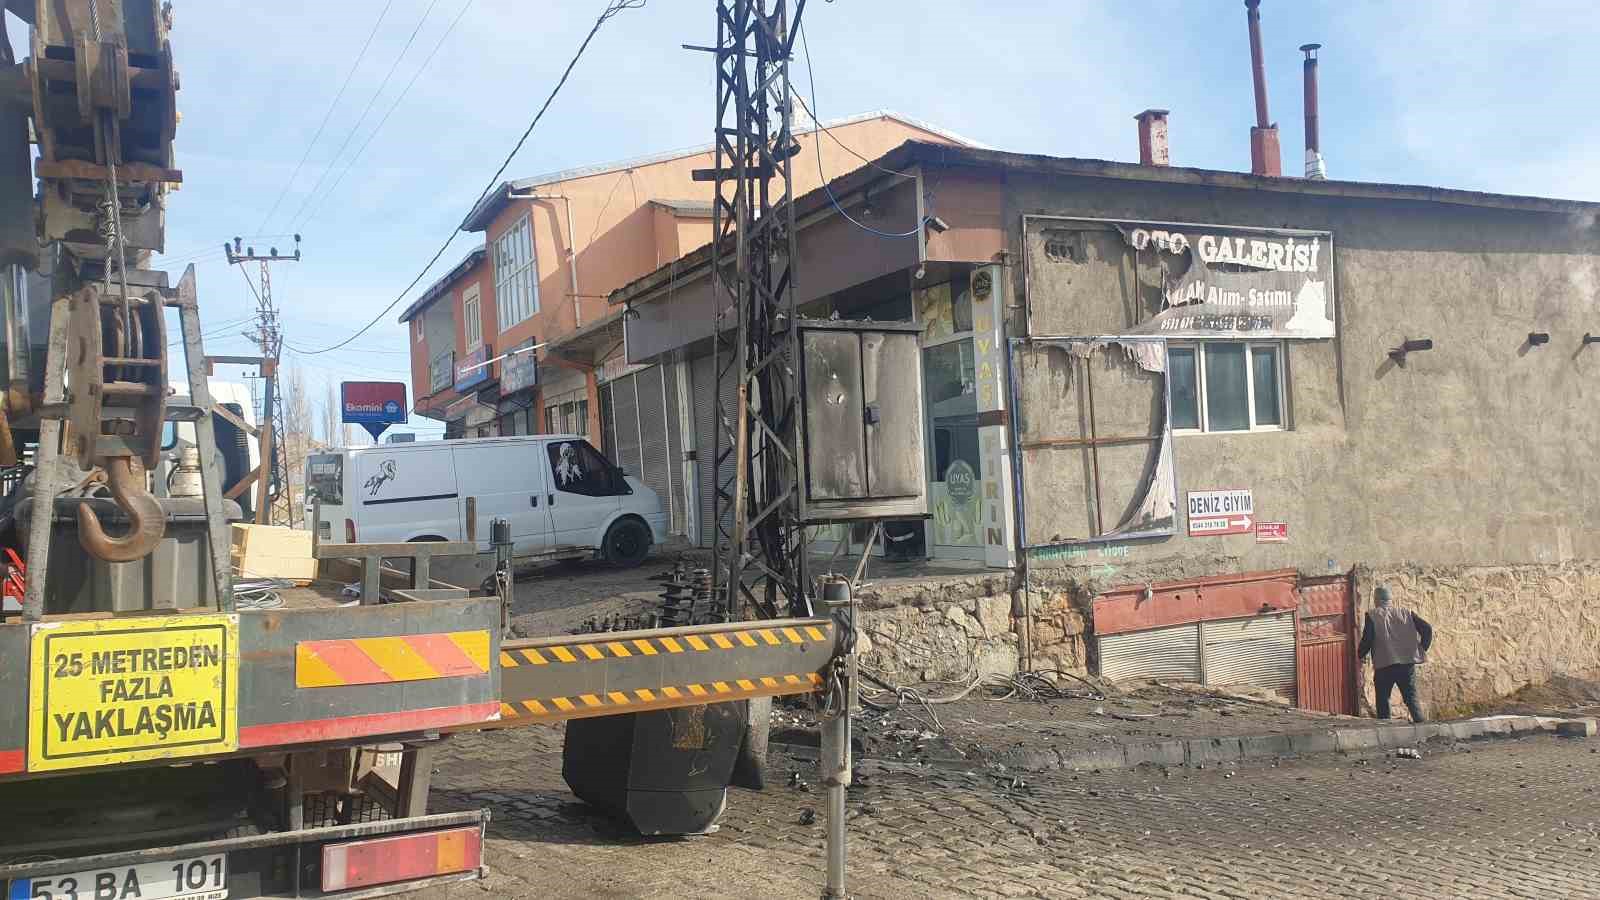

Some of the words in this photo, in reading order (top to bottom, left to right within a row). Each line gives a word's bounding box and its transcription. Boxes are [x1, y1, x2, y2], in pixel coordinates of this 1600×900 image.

[1198, 236, 1320, 272] GALERİSİ
[1190, 493, 1220, 514] DENİZ
[1223, 492, 1251, 512] GİYİM
[54, 653, 83, 678] 25
[91, 644, 218, 674] METREDEN
[99, 676, 173, 703] FAZLA
[54, 700, 217, 741] YAKLAŞMA
[32, 877, 79, 900] 53
[95, 868, 142, 900] BA
[172, 857, 224, 892] 101
